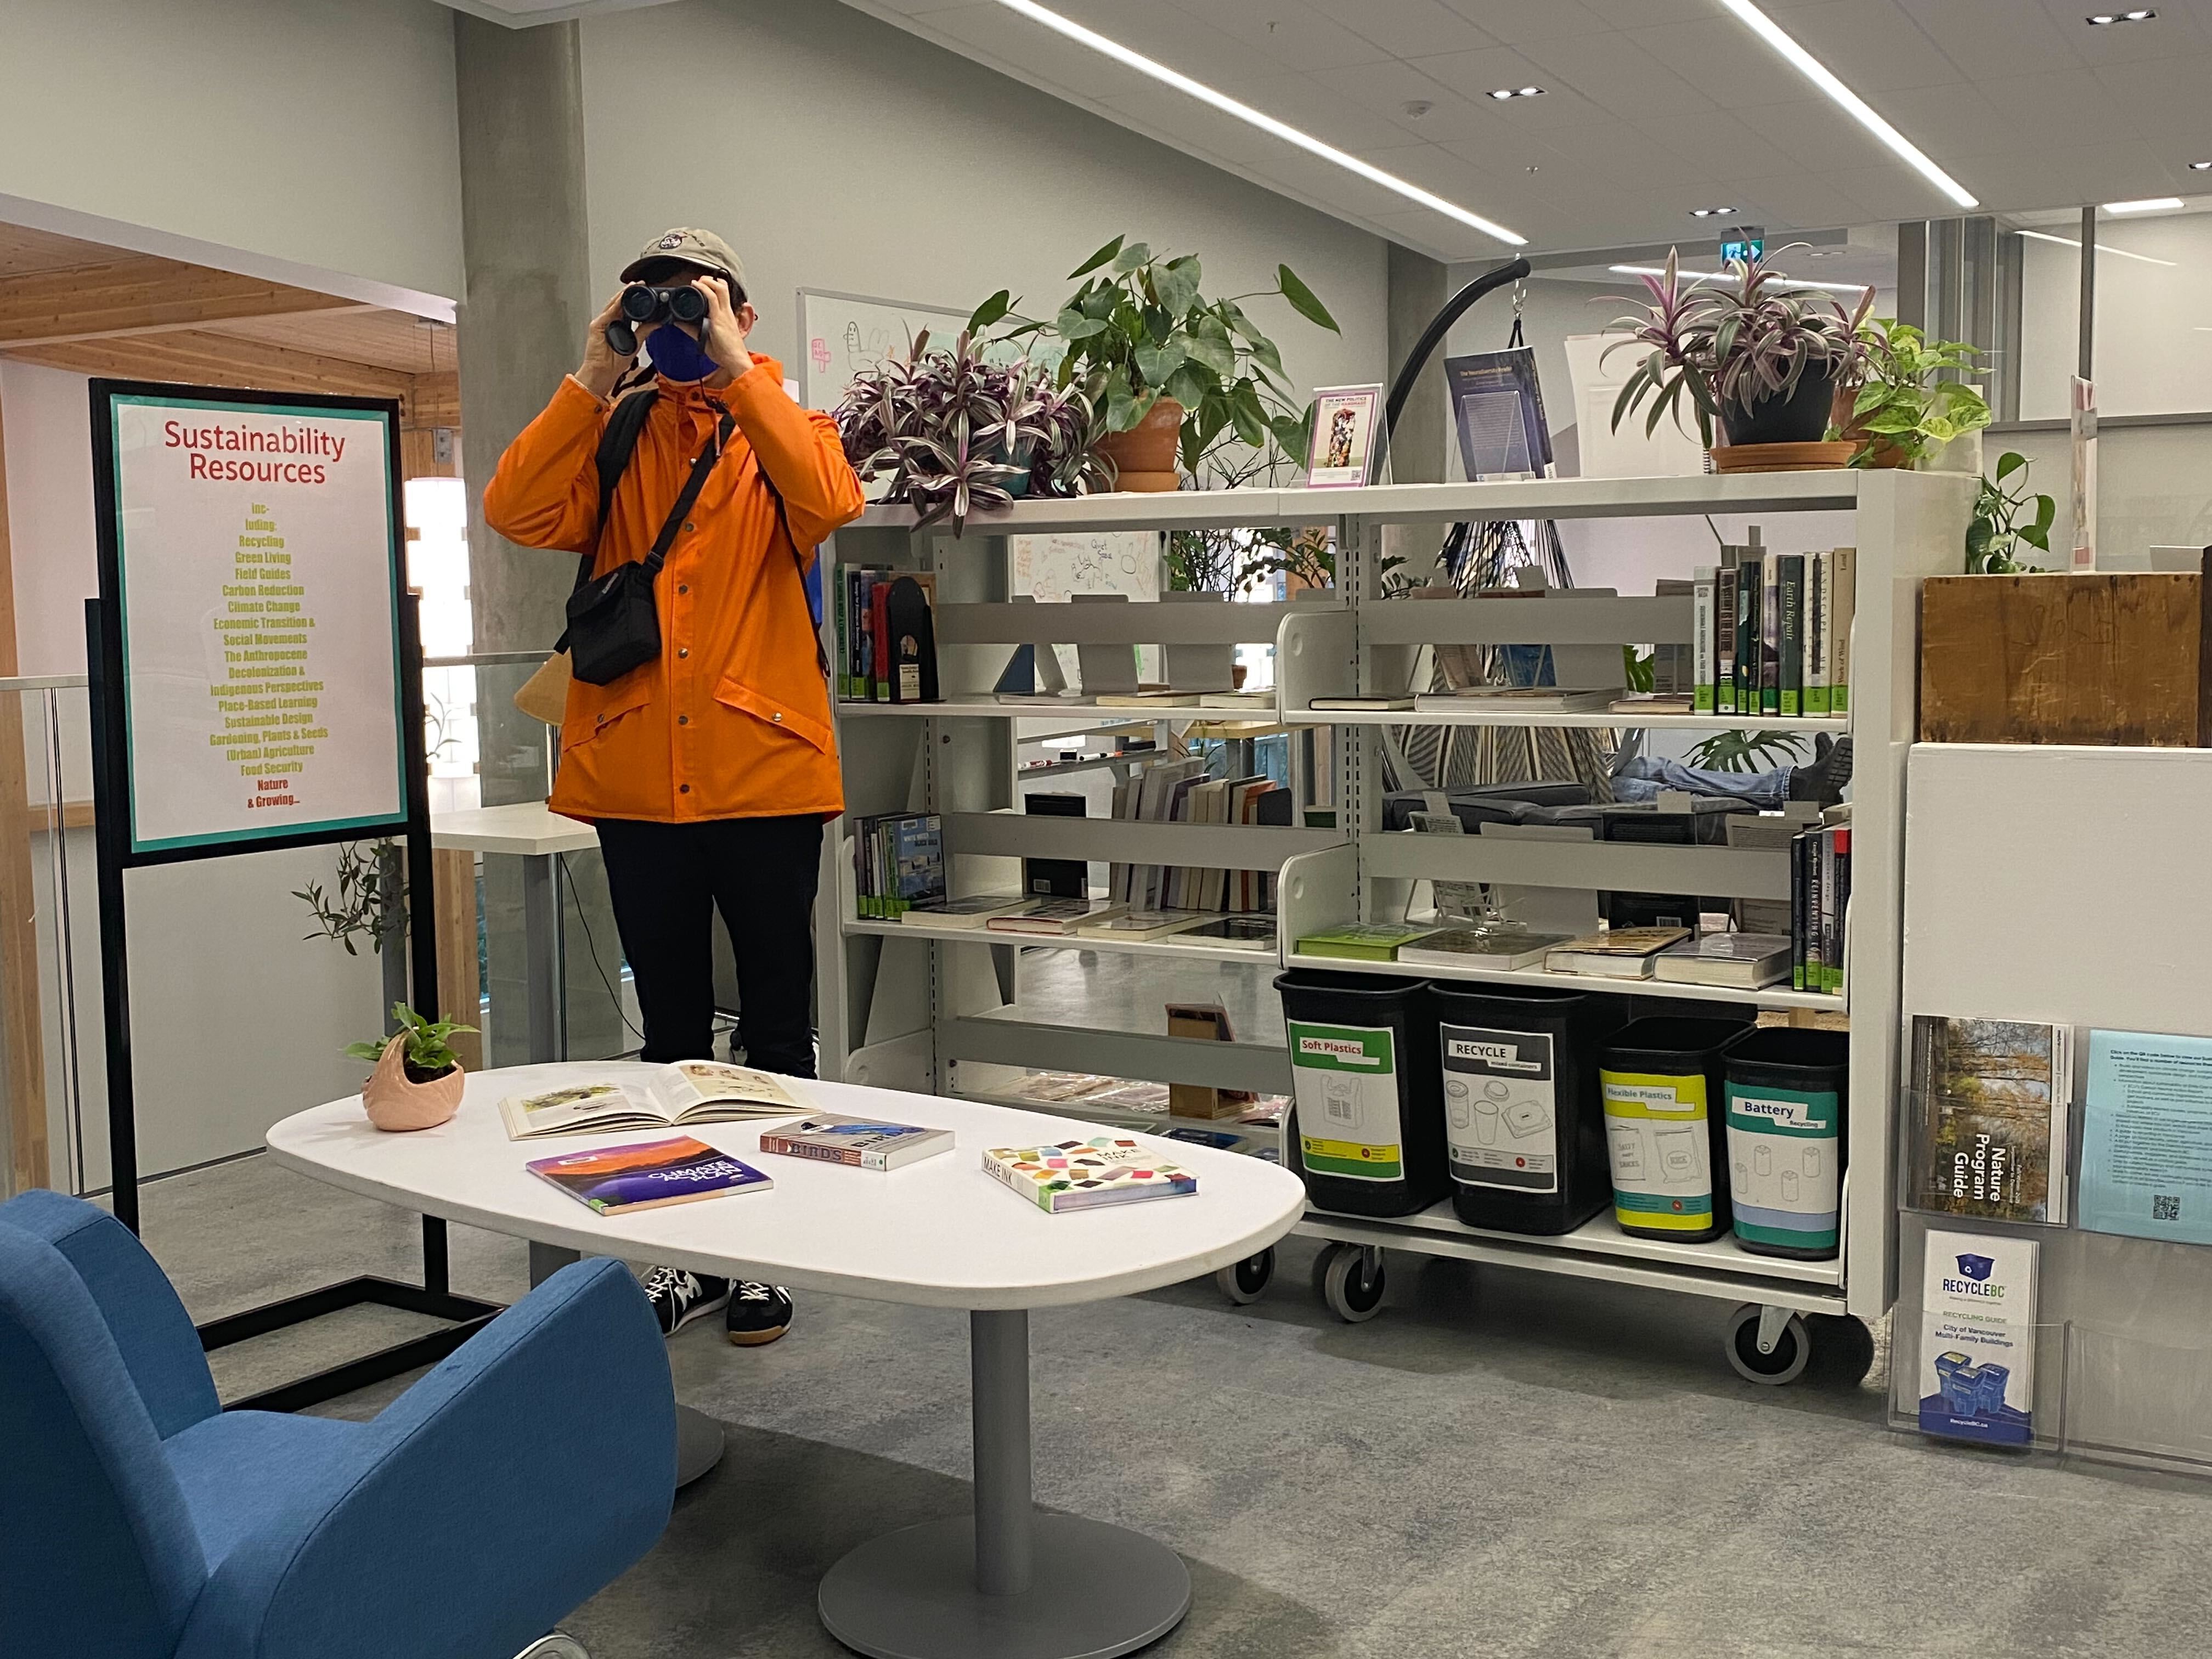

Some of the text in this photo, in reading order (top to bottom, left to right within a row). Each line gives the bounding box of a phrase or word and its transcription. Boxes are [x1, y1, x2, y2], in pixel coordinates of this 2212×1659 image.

[164, 420, 346, 462] Sustainability
[190, 452, 325, 484] Resources
[239, 535, 284, 548] Recycling
[235, 552, 291, 565] Green Living
[235, 568, 291, 579] Field Guides
[223, 585, 304, 596] Carbon Reduction
[228, 601, 300, 613] Climate Change
[1782, 580, 1796, 640] Earth Repair
[214, 617, 315, 629] Economic Transition &
[224, 633, 307, 646] Social Movements
[225, 650, 307, 662] The Anthropocene
[229, 666, 305, 679] Decolonization &
[211, 680, 324, 696] Indigenous Perspectives
[218, 696, 318, 712] Place-Based Learning
[225, 713, 313, 729] Sustainable Design
[210, 727, 328, 746] Gardening, Plants & Seeds
[227, 745, 314, 761] (Urban) Agriculture
[241, 761, 303, 776] Food Security
[257, 780, 289, 791] Nature
[247, 798, 254, 808] &
[1811, 879, 1819, 936] REINVENTING
[1302, 1039, 1362, 1055] Soft Plastics
[1457, 1043, 1506, 1058] RECYCLE
[1607, 1087, 1672, 1101] Flexible Plastics
[1745, 1101, 1794, 1119] Battery
[1790, 1120, 1819, 1128] Recycling
[791, 1143, 842, 1161] BIRDS
[1097, 1148, 1143, 1157] MAKE
[648, 1160, 727, 1179] CLIMATE
[664, 1163, 737, 1181] ACTION
[690, 1167, 742, 1181] PLAN
[983, 1156, 1013, 1186] MAKE INK
[1973, 1133, 1990, 1200] Program
[1990, 1147, 2006, 1202] Nature
[1953, 1152, 1968, 1199] Guide
[1943, 1279, 2005, 1297] RECYCLEBC
[1943, 1311, 2007, 1324] RECYCLING GUIDE
[1936, 1331, 2014, 1347] Multi-Family Buildings
[1968, 1327, 2006, 1337] Vancouver
